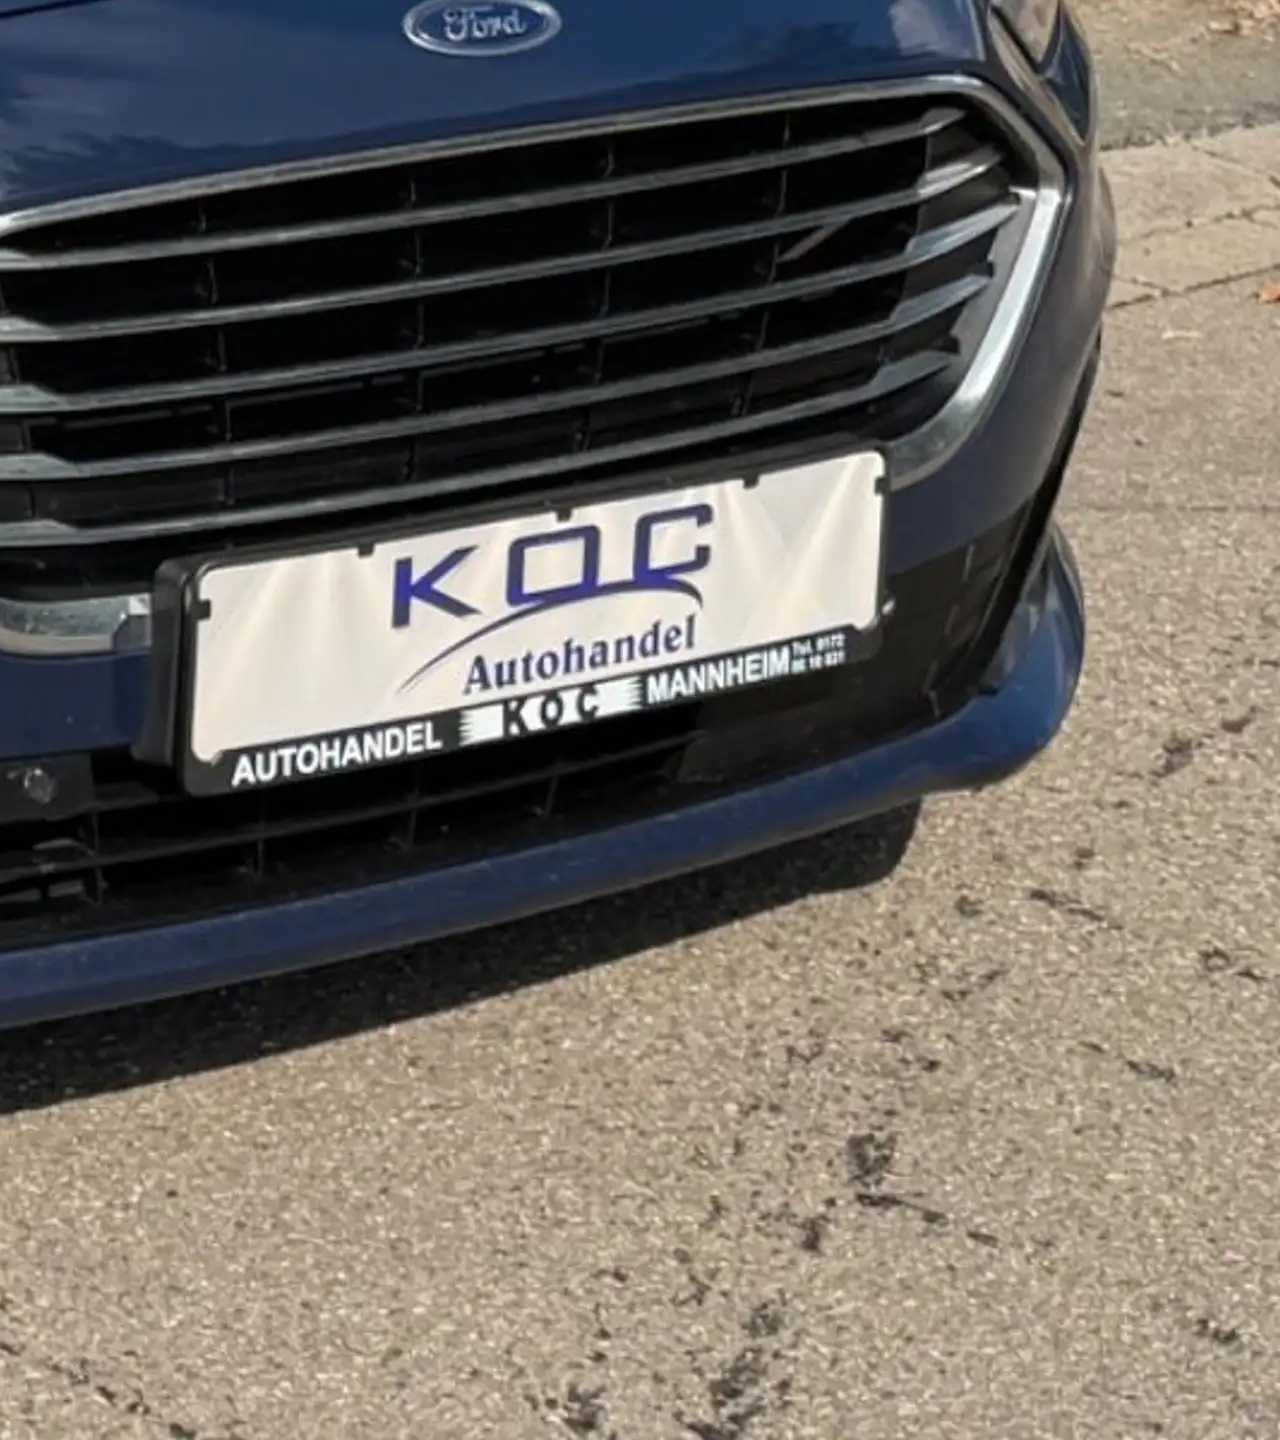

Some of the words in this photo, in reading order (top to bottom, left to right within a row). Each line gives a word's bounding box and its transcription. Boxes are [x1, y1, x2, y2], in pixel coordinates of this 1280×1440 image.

[442, 5, 527, 42] Ford
[391, 503, 714, 630] KOC
[463, 613, 696, 696] Autohandel
[231, 720, 443, 788] AUTOHANDEL
[647, 645, 790, 703] MANNHEIM
